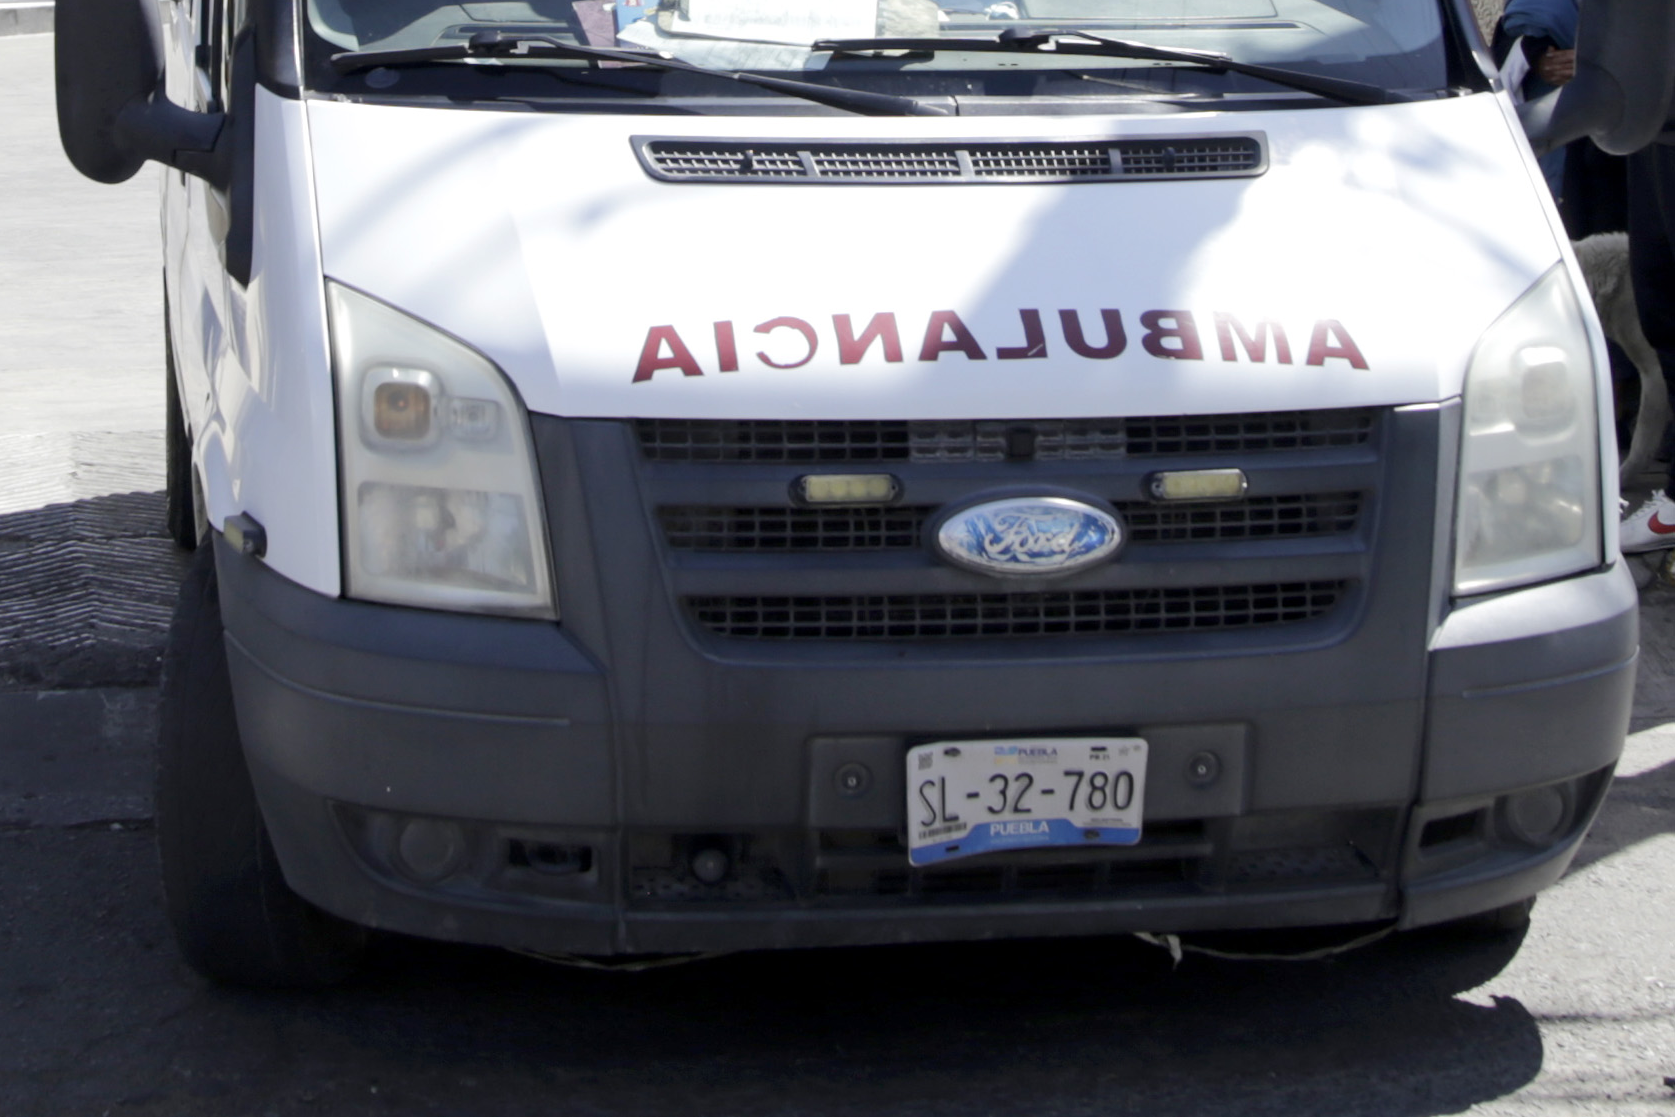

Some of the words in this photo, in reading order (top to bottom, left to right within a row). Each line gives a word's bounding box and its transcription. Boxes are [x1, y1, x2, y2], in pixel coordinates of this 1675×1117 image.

[984, 512, 1083, 558] Ford
[1017, 746, 1059, 757] PUEBLA
[918, 769, 1135, 828] SL-32-780
[989, 820, 1050, 836] PUEBLA
